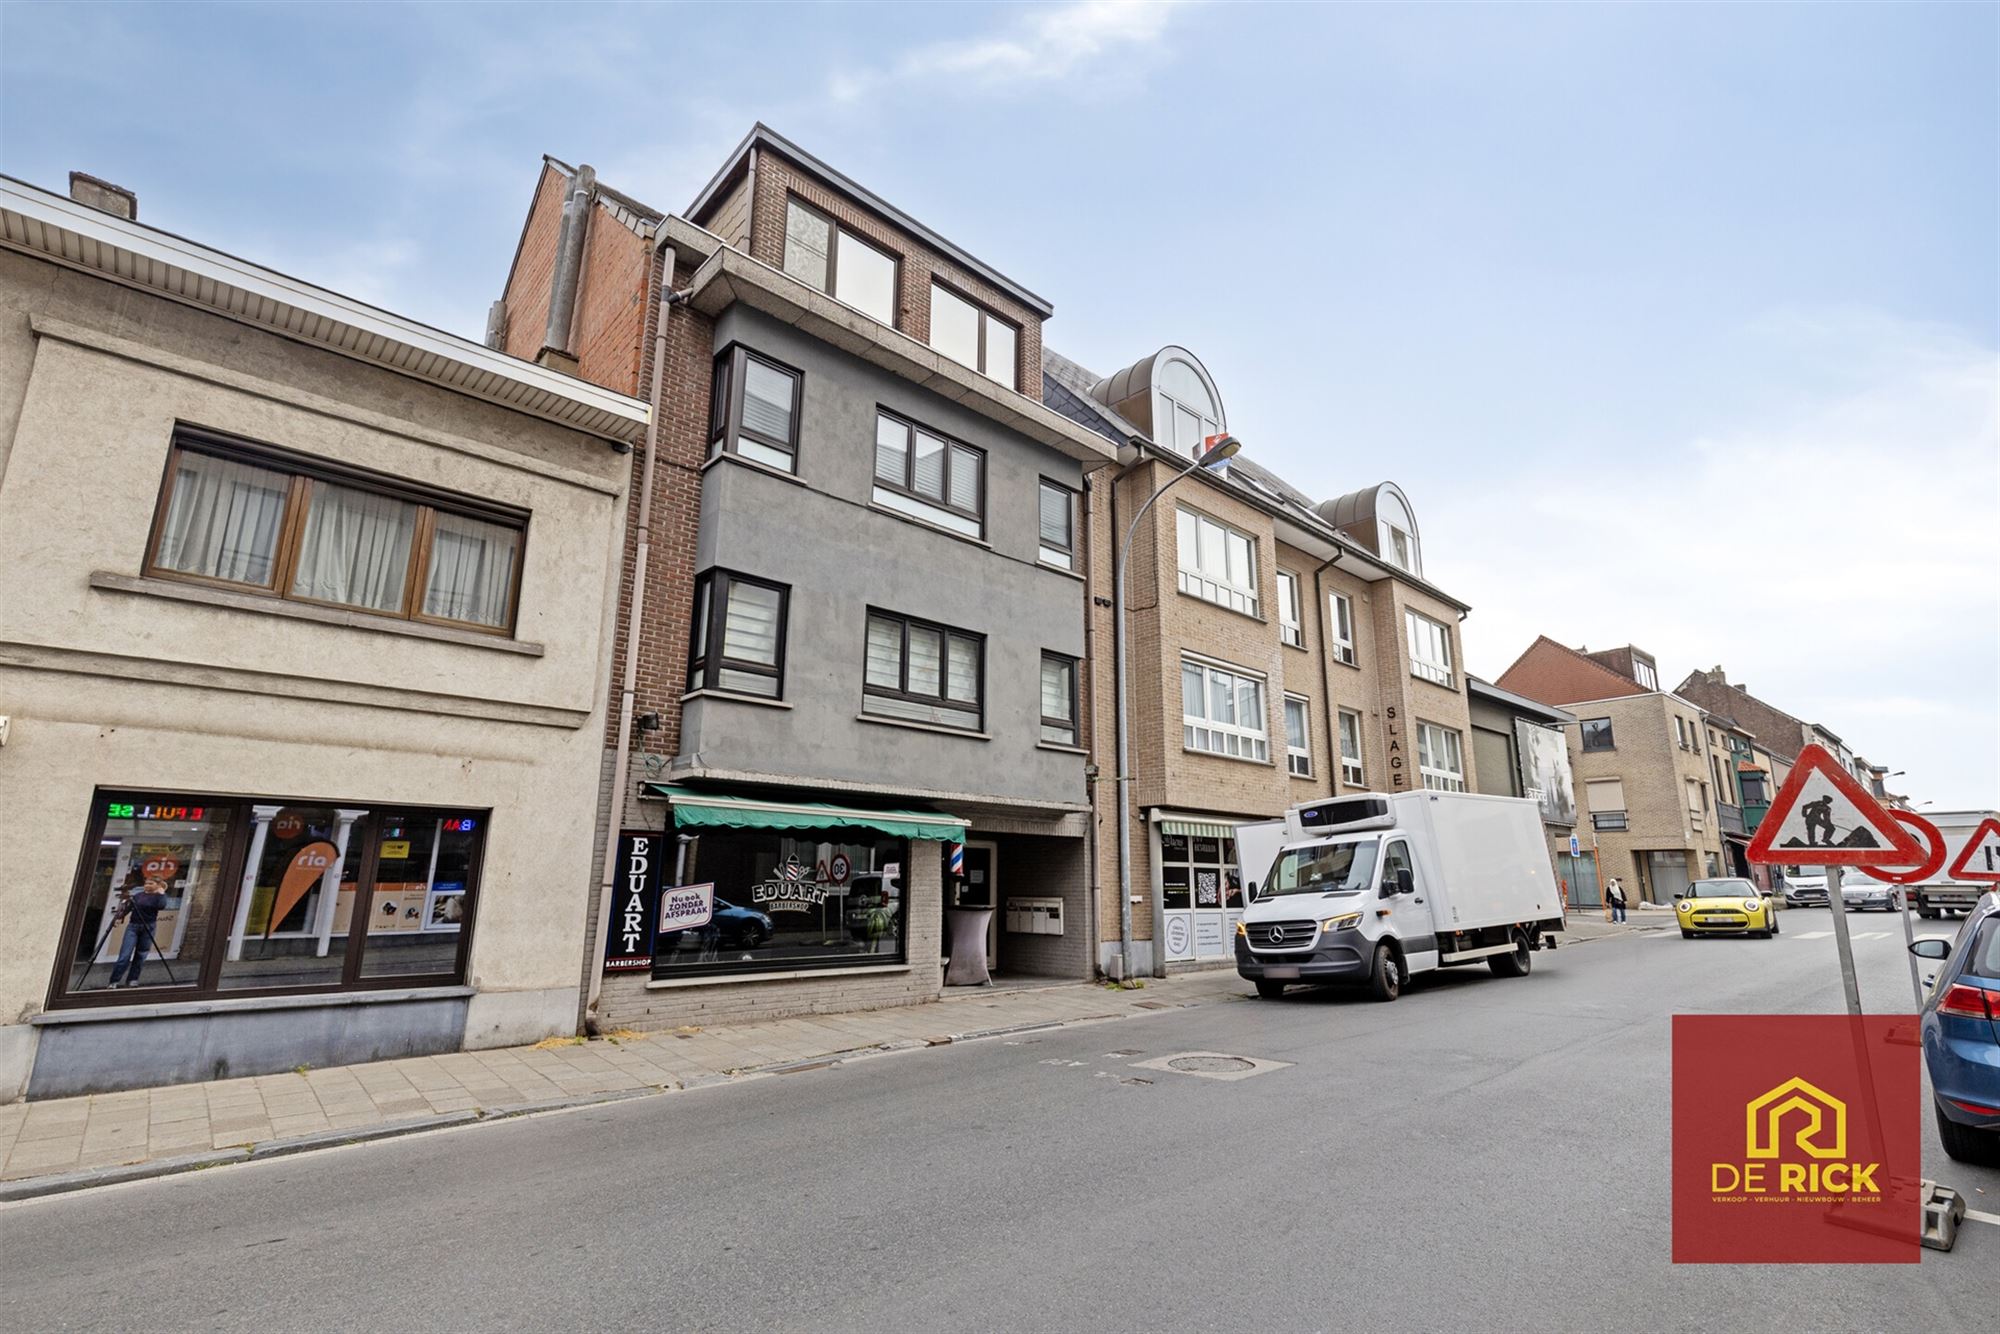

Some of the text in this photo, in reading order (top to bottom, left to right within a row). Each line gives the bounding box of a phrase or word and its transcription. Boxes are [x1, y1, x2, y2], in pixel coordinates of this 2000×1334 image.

[1387, 707, 1403, 793] SLAGE
[298, 850, 327, 866] ria
[622, 837, 649, 952] EDUART
[671, 896, 683, 904] Nu
[752, 882, 829, 904] EDUART
[665, 906, 707, 919] AFSPRAAK
[669, 900, 703, 911] ZONDER
[605, 959, 651, 968] BARBERSHOP
